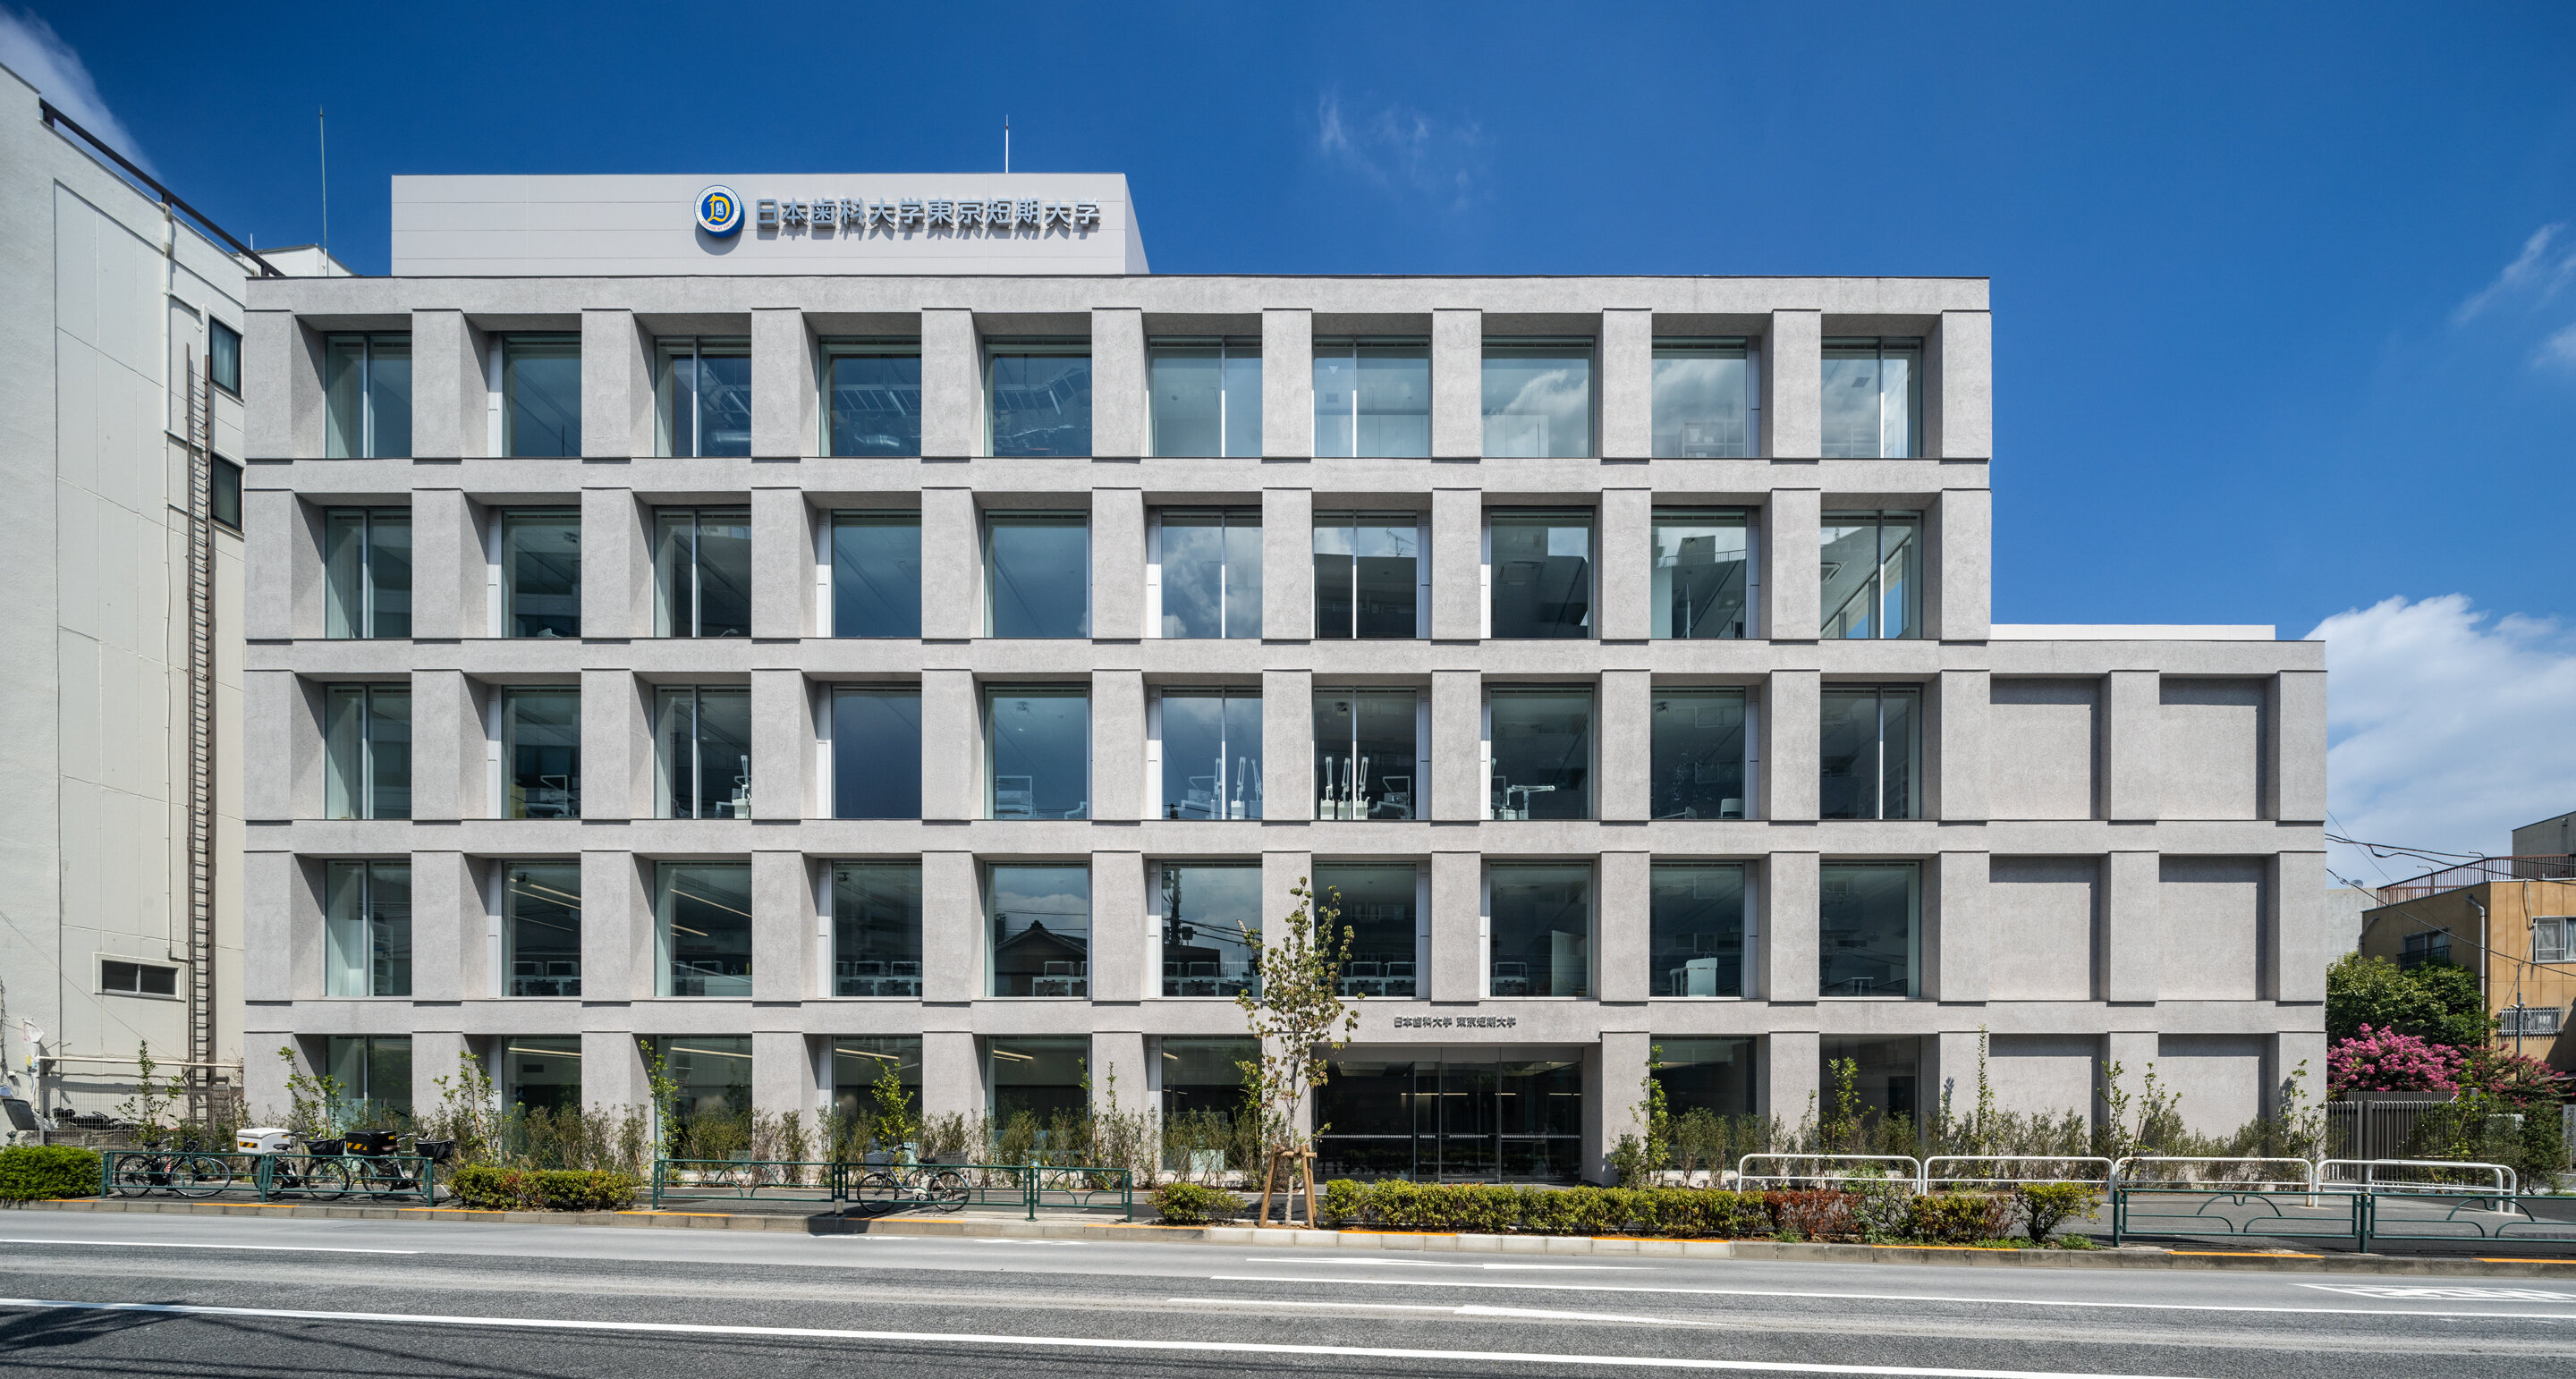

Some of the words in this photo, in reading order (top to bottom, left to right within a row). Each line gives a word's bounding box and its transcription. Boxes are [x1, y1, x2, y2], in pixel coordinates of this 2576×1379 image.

[757, 198, 1101, 224] 日本歯科大学東京短期大学
[1394, 1016, 1453, 1028] 日本歯科大学
[1456, 1016, 1517, 1028] 東京短期大学
